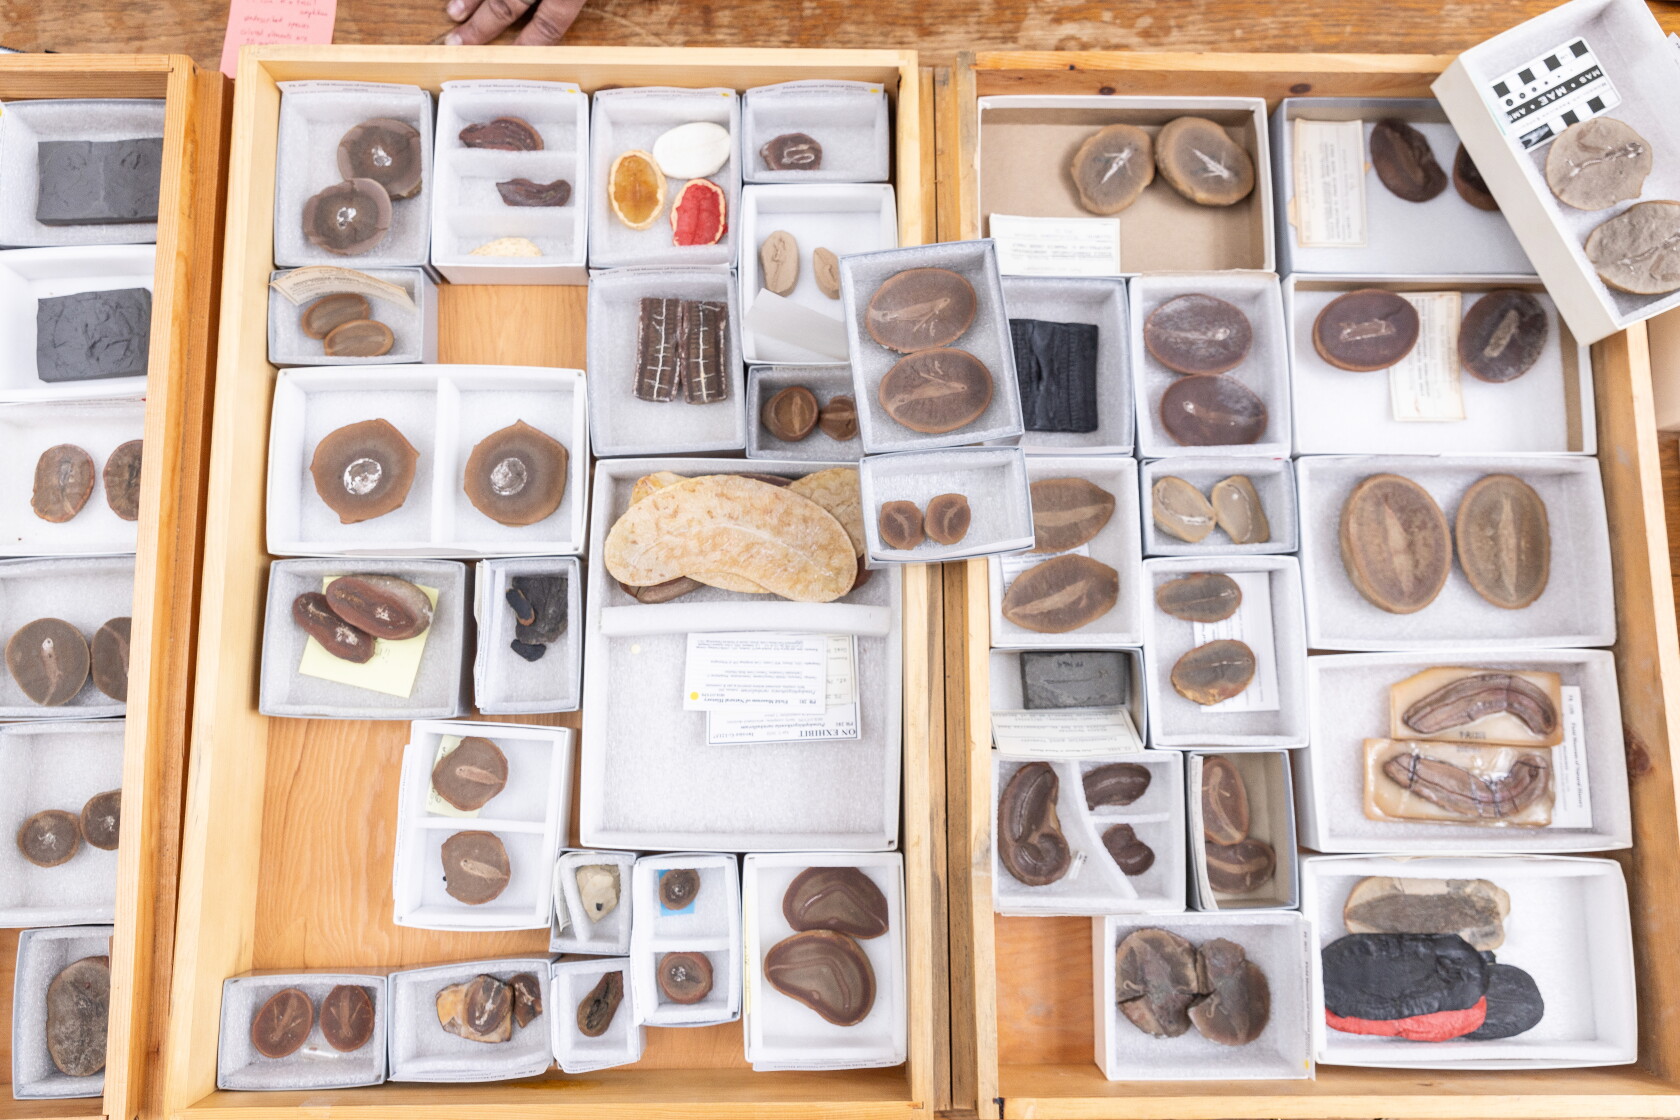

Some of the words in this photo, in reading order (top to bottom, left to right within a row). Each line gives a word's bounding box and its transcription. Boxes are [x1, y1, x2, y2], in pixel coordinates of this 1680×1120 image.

[1578, 68, 1601, 84] MAS
[1537, 85, 1568, 106] MAE
[800, 729, 839, 737] EXHIBIT
